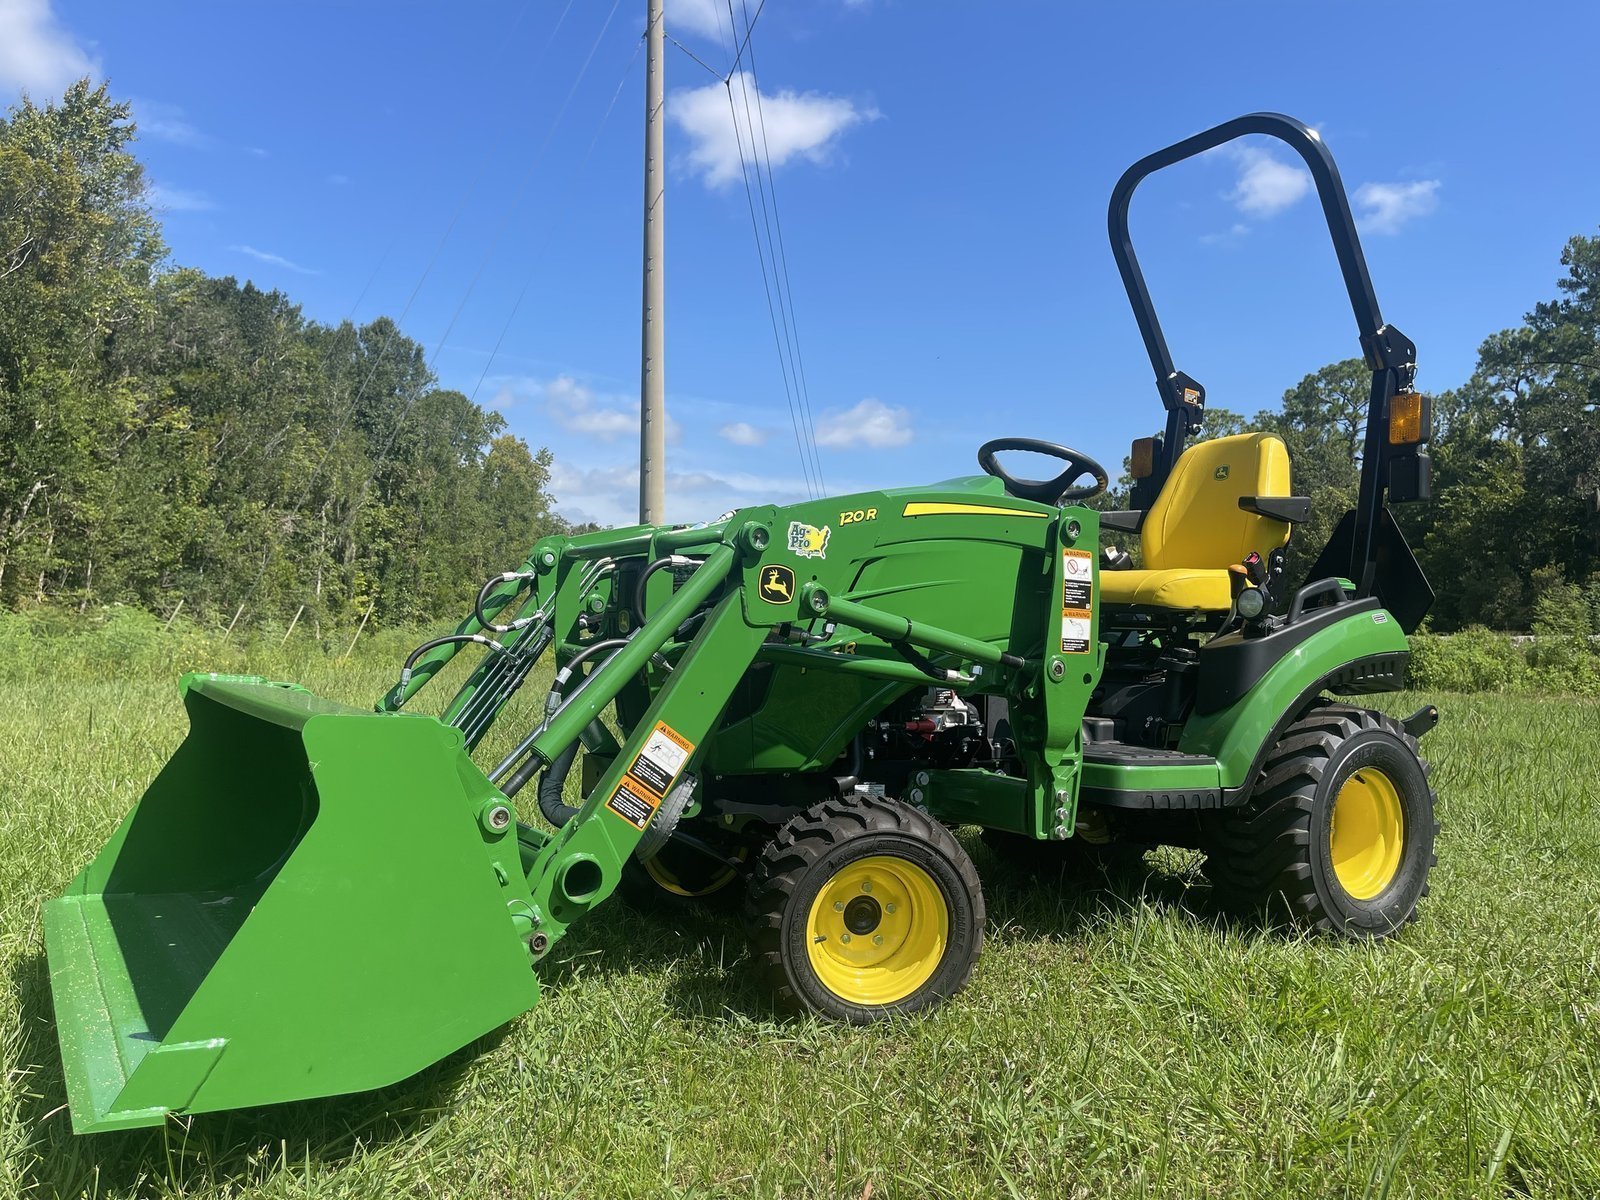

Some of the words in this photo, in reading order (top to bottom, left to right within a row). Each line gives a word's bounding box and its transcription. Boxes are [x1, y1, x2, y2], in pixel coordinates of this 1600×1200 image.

[791, 536, 810, 547] Pro
[666, 729, 690, 750] WARNING
[631, 785, 656, 805] WARNING
